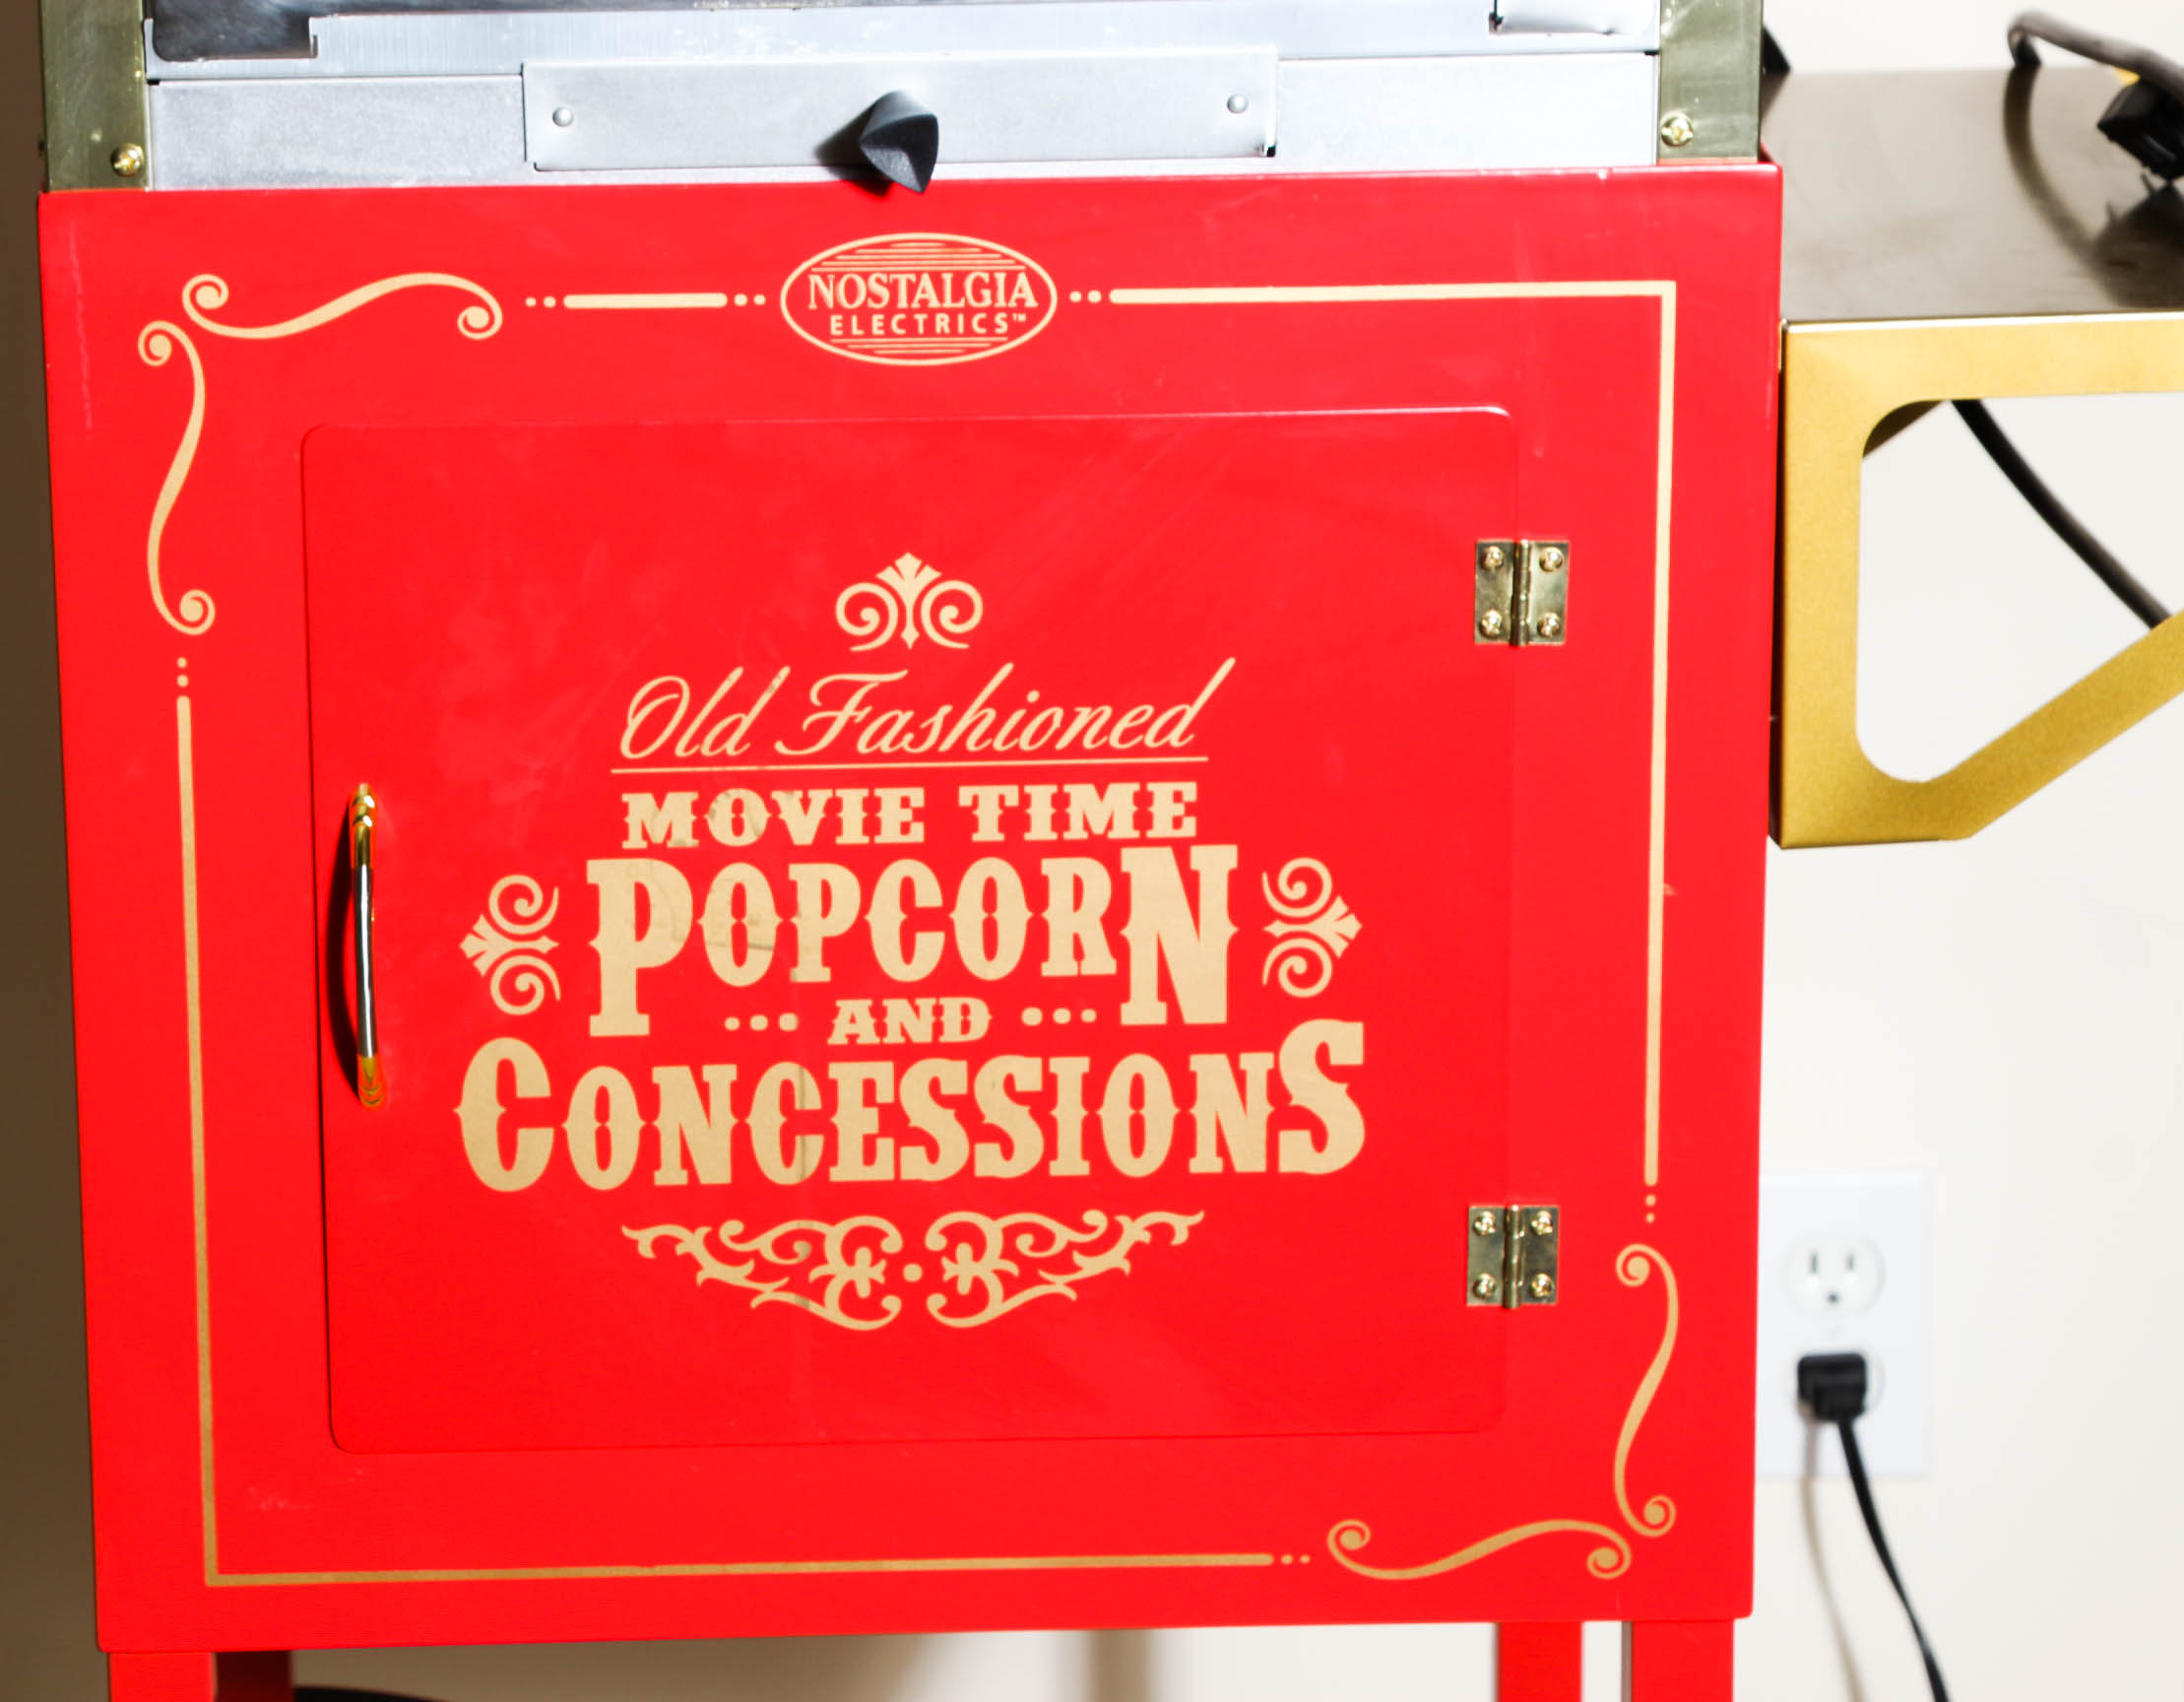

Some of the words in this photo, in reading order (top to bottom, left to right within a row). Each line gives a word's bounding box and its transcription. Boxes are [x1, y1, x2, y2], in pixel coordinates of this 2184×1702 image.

[807, 272, 1039, 310] NOSTALGIA
[619, 666, 791, 759] Old
[774, 657, 1237, 756] Fashioned
[621, 787, 926, 850] MOVIE
[958, 781, 1198, 842] TIME
[586, 843, 1240, 1037] POPCORN
[826, 997, 994, 1046] AND
[453, 1018, 1366, 1192] CONCESSIONS
